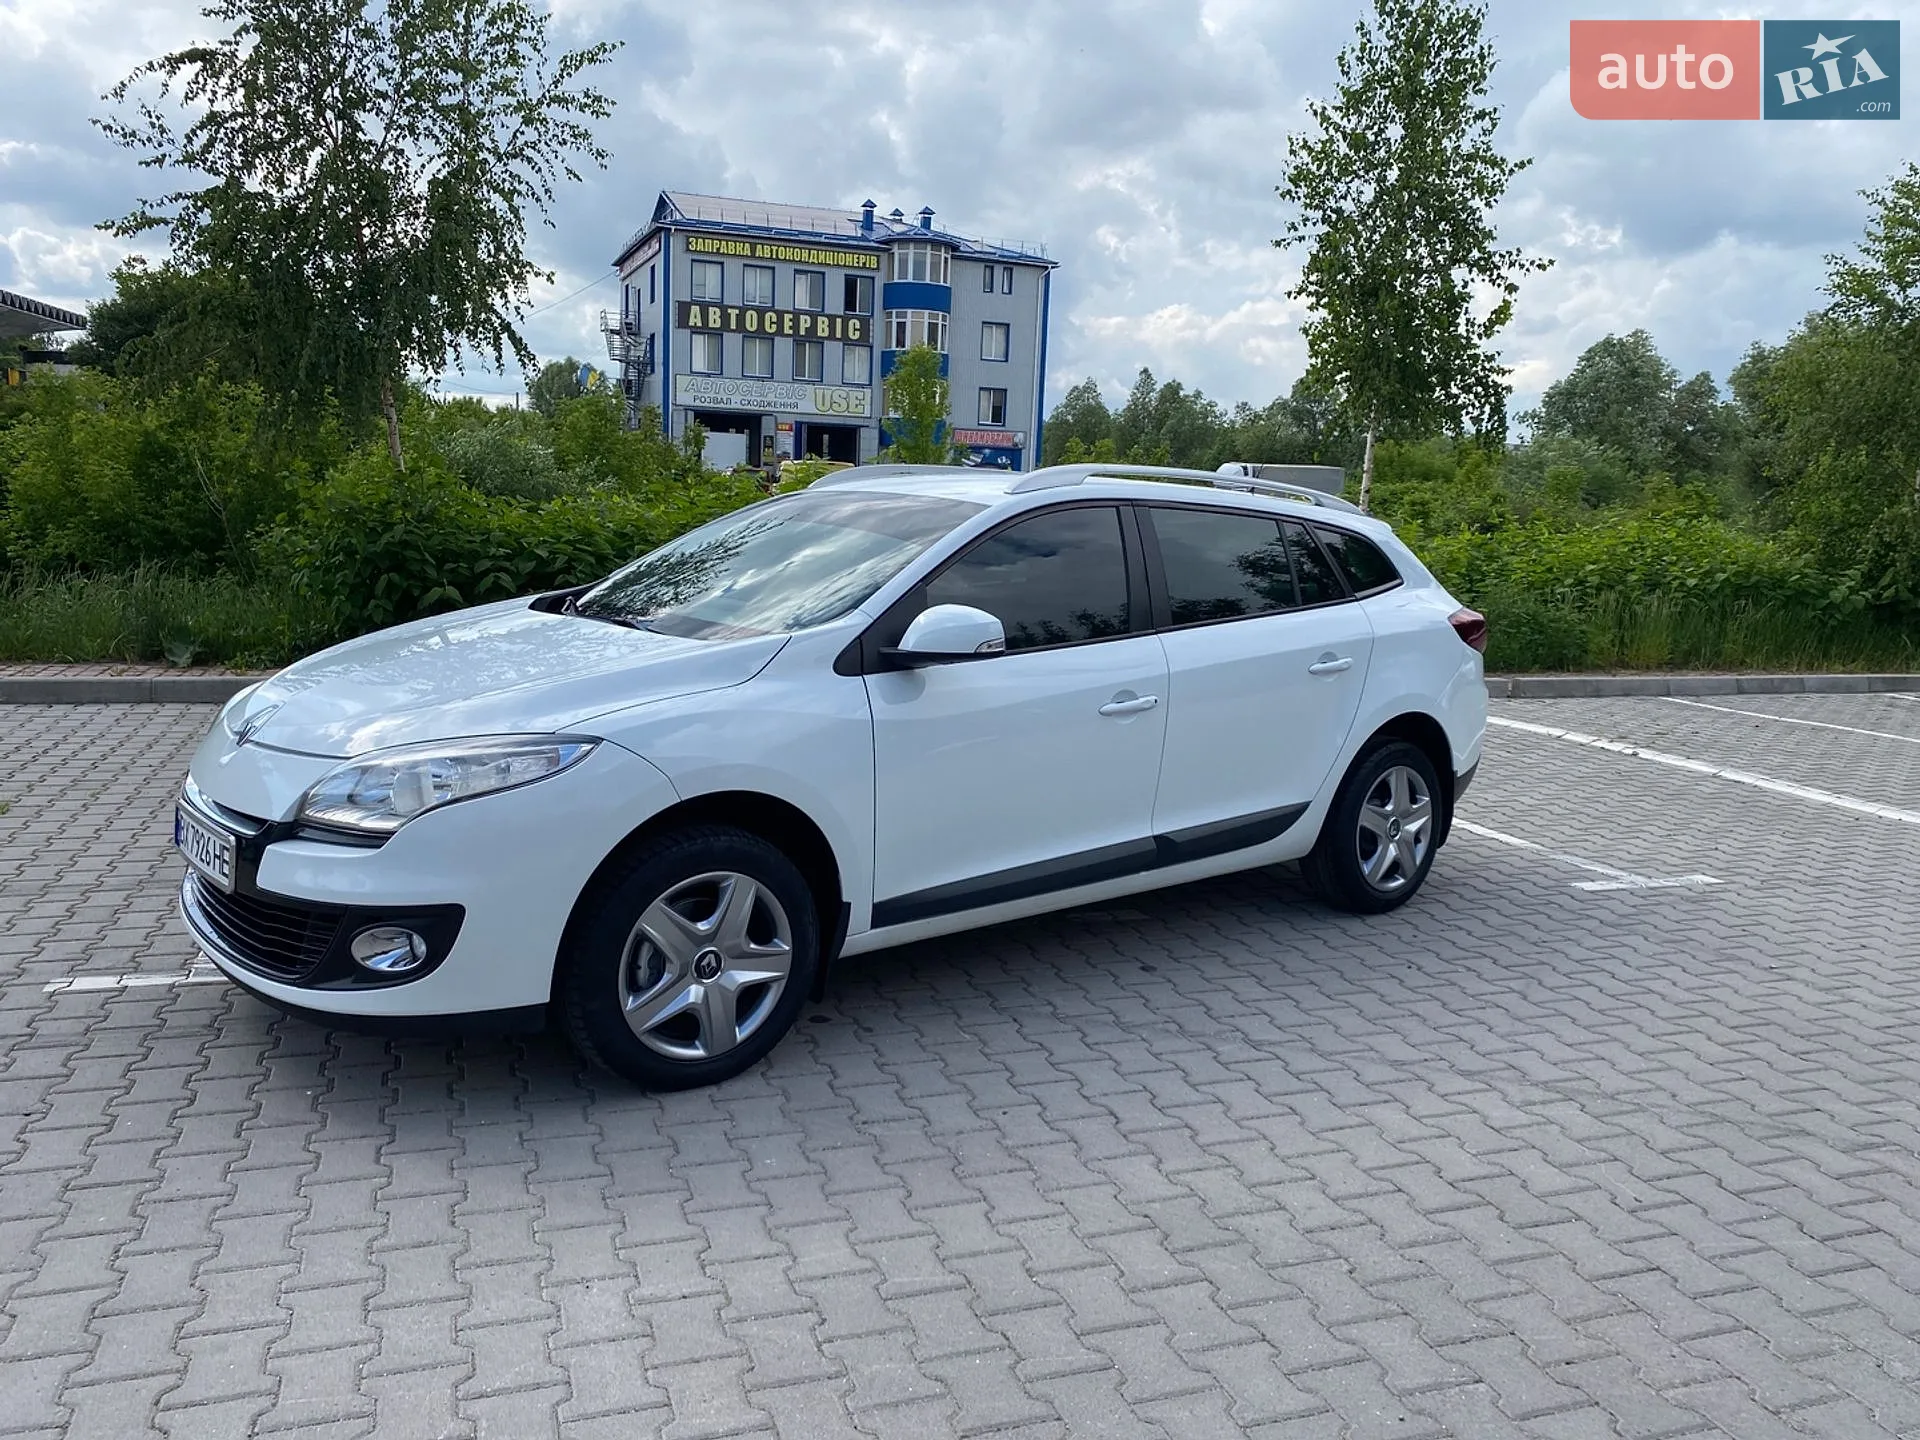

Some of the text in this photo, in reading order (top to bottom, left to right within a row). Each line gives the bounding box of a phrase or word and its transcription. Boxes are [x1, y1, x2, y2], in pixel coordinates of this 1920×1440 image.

[688, 237, 878, 268] ЗАПРАВКА АВТОКОНДИЦІОНЕРІВ
[688, 305, 861, 340] АВТОСЕРВІС
[685, 378, 809, 401] АВТОСЕРВІС
[693, 394, 732, 406] РОЗВАЛ
[740, 398, 799, 410] СХОДЖЕННЯ
[814, 386, 866, 415] USE
[191, 823, 212, 867] 7926
[212, 840, 230, 879] HE
